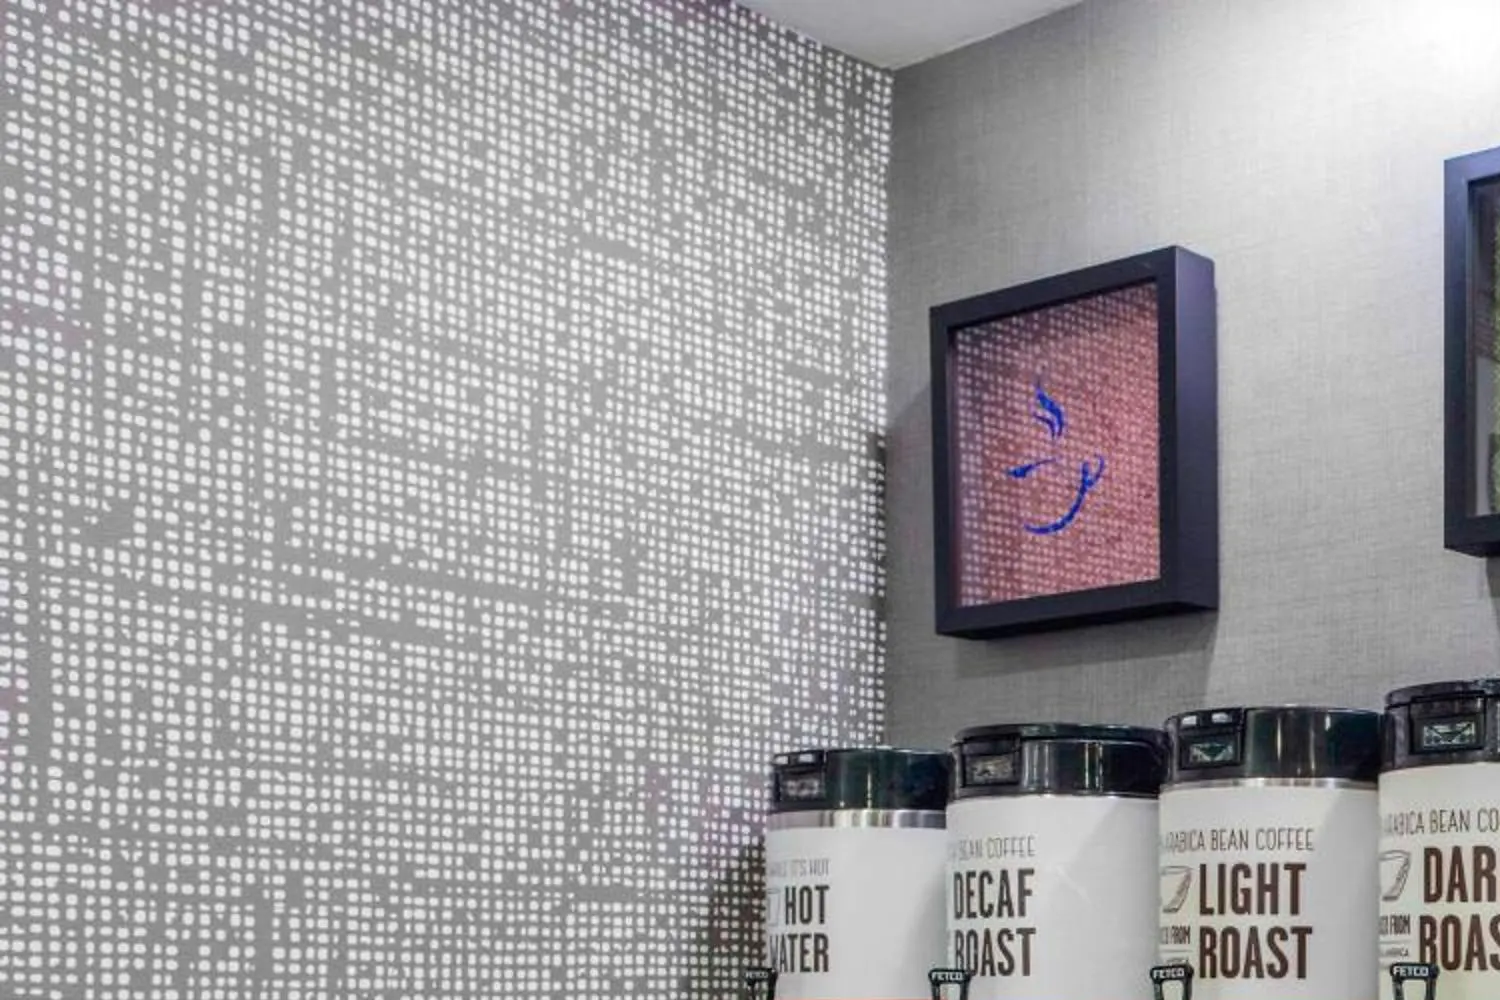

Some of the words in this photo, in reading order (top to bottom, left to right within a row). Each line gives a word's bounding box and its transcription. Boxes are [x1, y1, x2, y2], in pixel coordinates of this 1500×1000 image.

[1210, 828, 1249, 851] BEAN
[1255, 828, 1315, 851] COFFEE
[1429, 808, 1471, 834] BEAN
[986, 835, 1036, 859] COFFEE
[784, 884, 830, 926] HOT
[953, 867, 1036, 920] DECAF
[1200, 862, 1306, 916] LIGHT
[954, 926, 1037, 977] ROAST
[1200, 924, 1313, 980] ROAST
